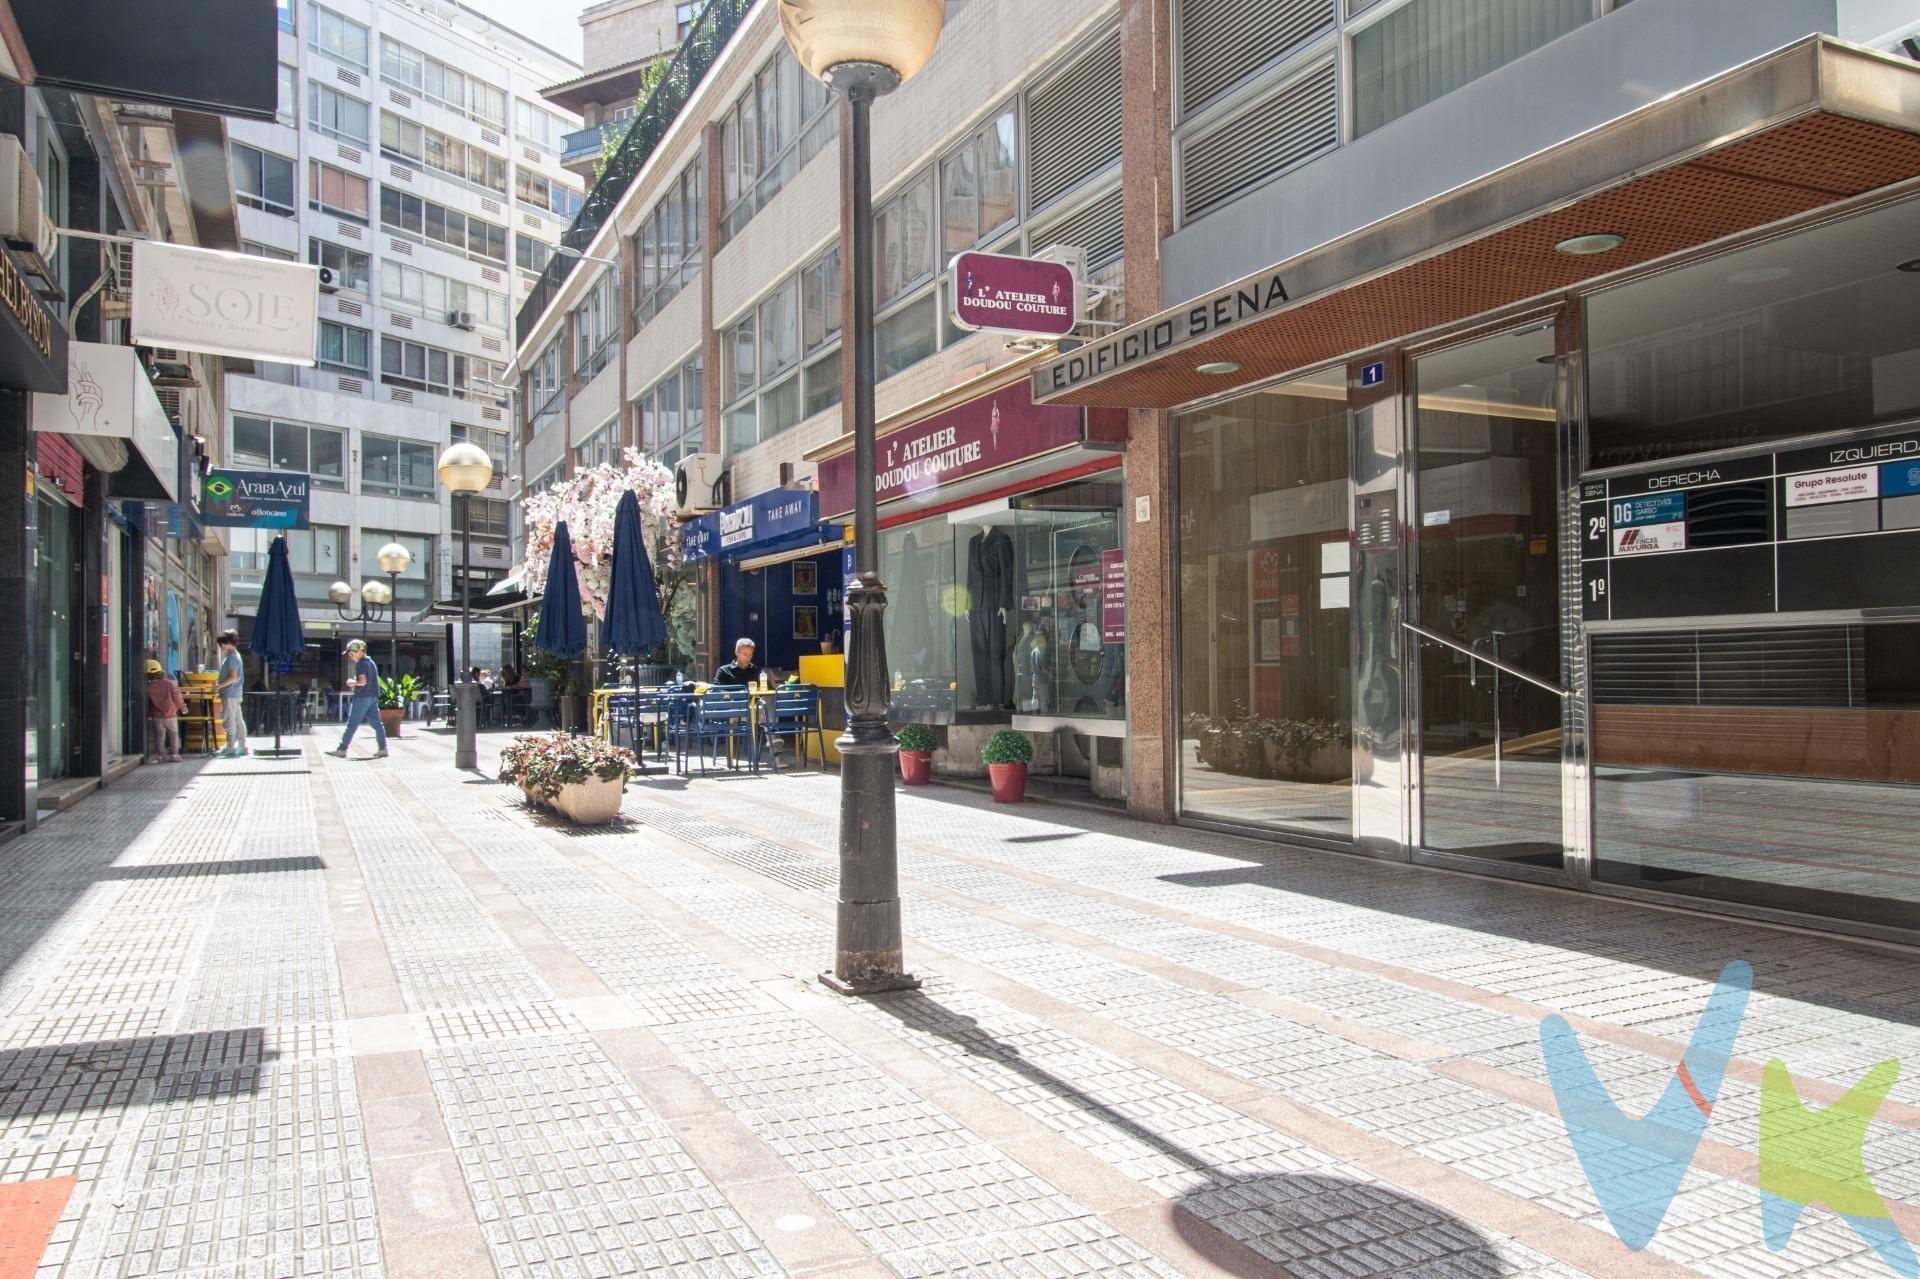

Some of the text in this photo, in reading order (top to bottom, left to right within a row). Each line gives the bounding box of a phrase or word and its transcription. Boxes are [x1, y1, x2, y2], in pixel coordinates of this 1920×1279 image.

[186, 282, 295, 332] SOLE
[963, 296, 1068, 316] DOUDOU COUTURE
[995, 290, 1047, 304] ATELIER
[1053, 275, 1289, 389] EDIFICIO SENA
[1369, 366, 1376, 382] 1
[903, 426, 957, 462] ATELIER
[1830, 440, 1920, 464] IZQUIERD
[875, 440, 981, 492] DOUDOU COUTURE
[1648, 469, 1721, 489] DERECHA
[1794, 472, 1868, 489] Grupo Resolute
[1584, 489, 1604, 497] SENA
[1635, 498, 1672, 509] DETECTIVES
[767, 506, 783, 523] TAKE
[784, 500, 802, 516] AWAY
[1613, 502, 1632, 524] DG
[1635, 507, 1657, 515] GARBO
[1589, 516, 1606, 540] 2º
[1636, 536, 1658, 545] FINCAS
[1588, 578, 1605, 601] 1º
